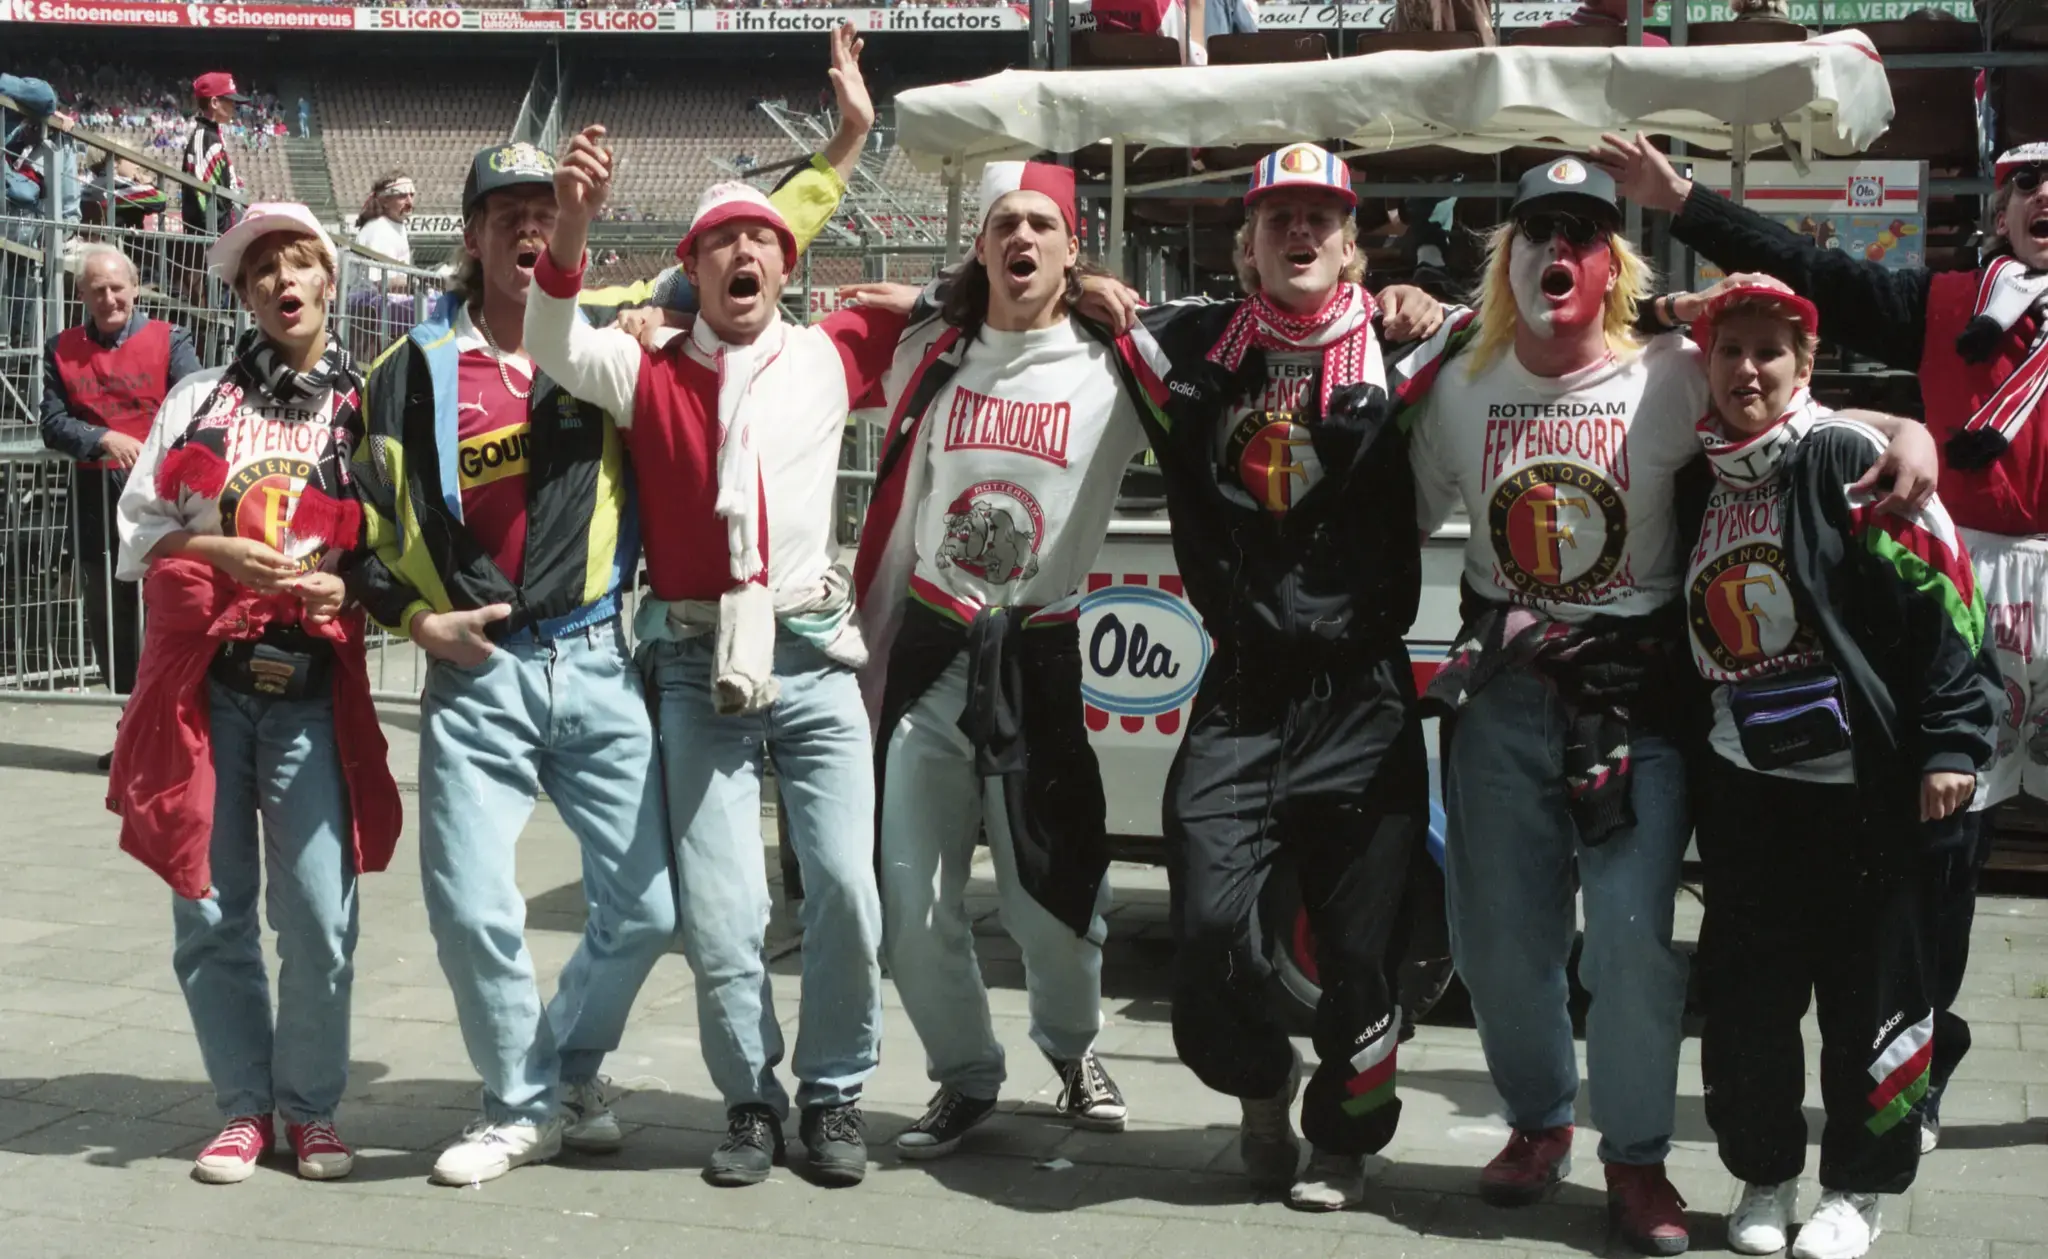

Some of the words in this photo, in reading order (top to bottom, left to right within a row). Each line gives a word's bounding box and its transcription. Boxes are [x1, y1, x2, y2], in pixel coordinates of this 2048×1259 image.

[39, 2, 179, 24] Schoenenreus
[213, 6, 352, 27] Schoenenreus
[736, 11, 765, 30] ifn
[768, 11, 847, 30] factors
[890, 10, 918, 29] ifn
[923, 10, 1000, 29] factors
[1856, 184, 1875, 197] Ola
[1488, 401, 1627, 418] ROTTERDAM
[945, 385, 1072, 468] FEYENOORD
[1481, 418, 1630, 494] FEYENOORD
[1496, 466, 1617, 509] FEYENOORD
[974, 482, 1040, 518] ROTTERDAM
[1089, 612, 1180, 679] Ola
